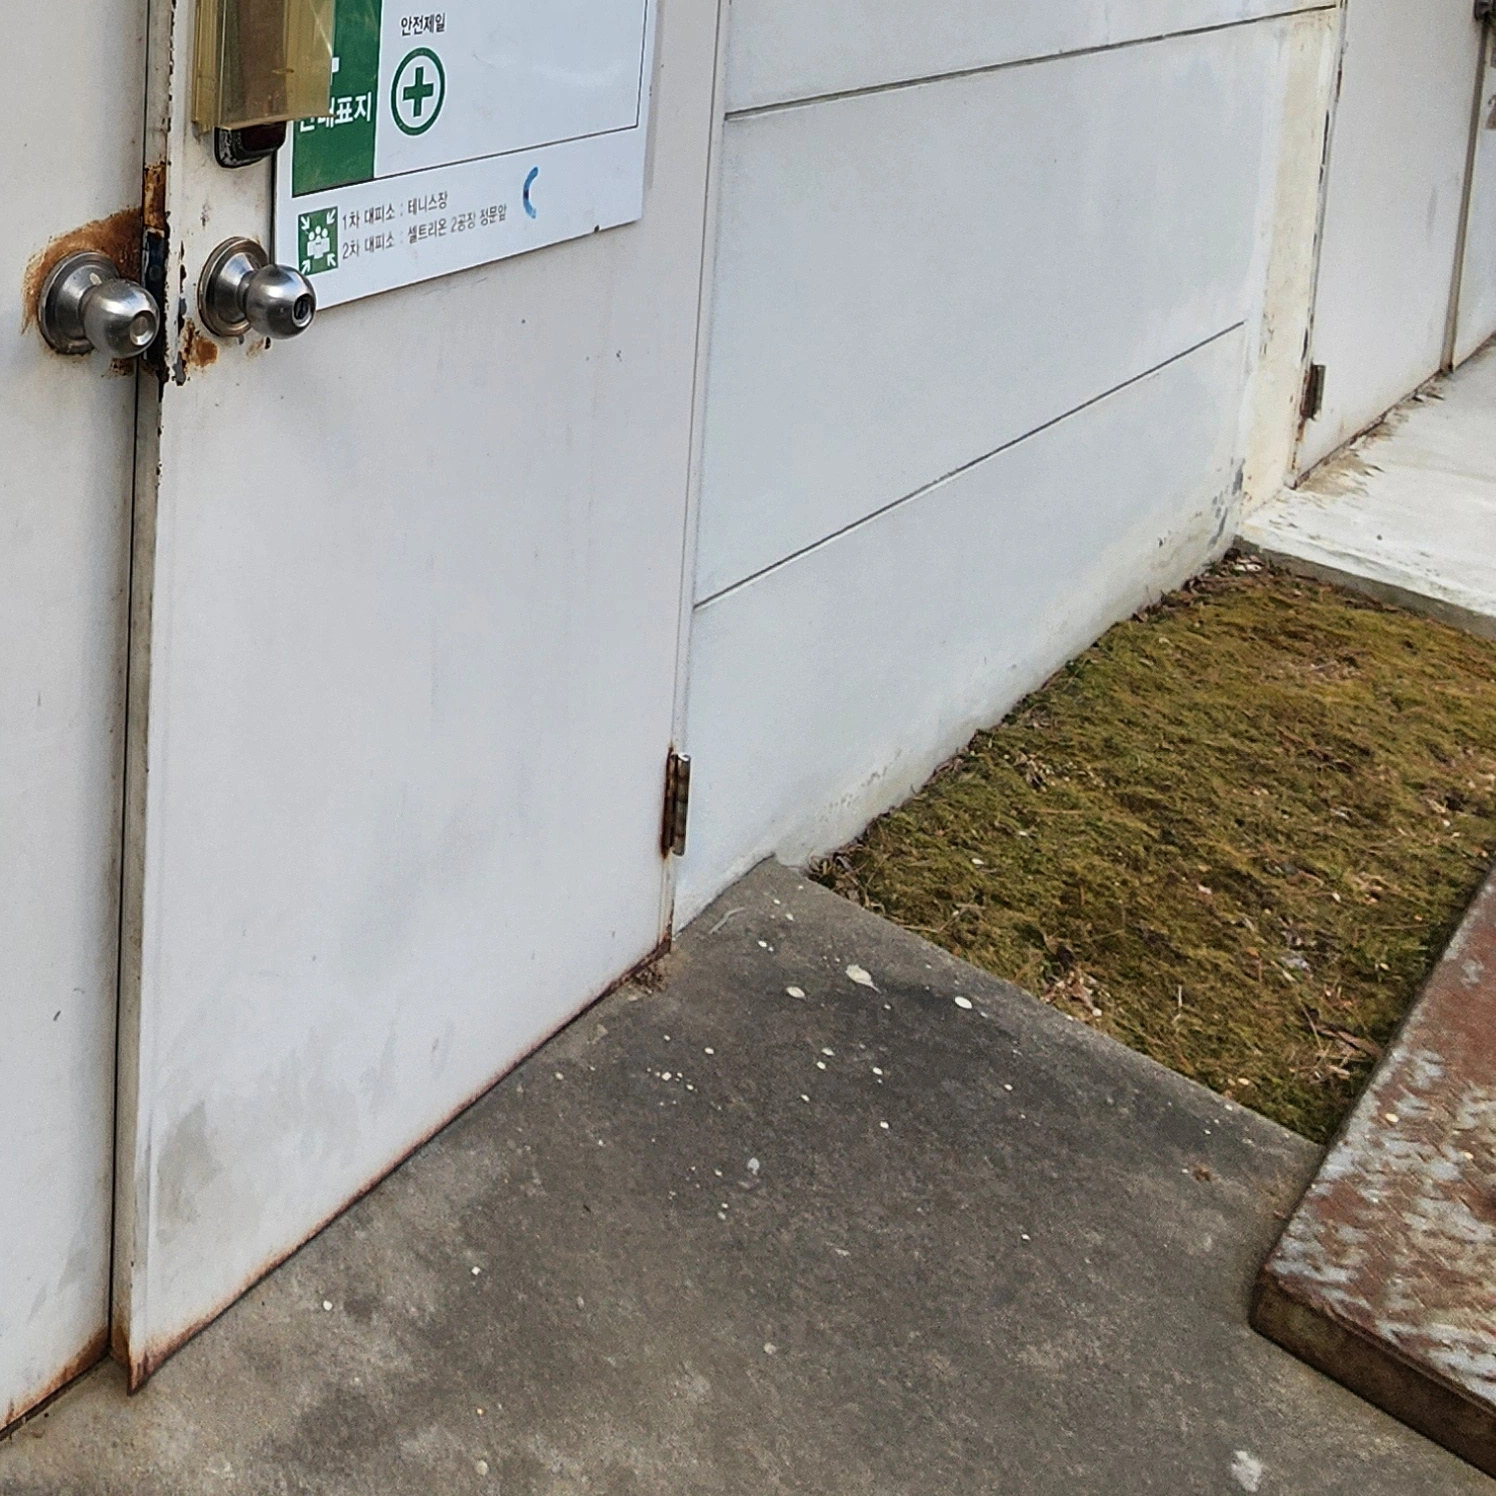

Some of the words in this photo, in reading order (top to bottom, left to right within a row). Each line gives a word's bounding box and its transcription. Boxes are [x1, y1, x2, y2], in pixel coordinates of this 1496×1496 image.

[401, 13, 446, 37] 안전제일
[342, 212, 360, 231] 1차
[364, 205, 396, 225] 대피소
[407, 191, 448, 216] 테니스장
[342, 239, 360, 260] 2차
[364, 231, 396, 252] 대피소
[407, 219, 448, 244] 셀트리온
[451, 210, 476, 232] 2공장
[480, 205, 507, 226] 정문앞
